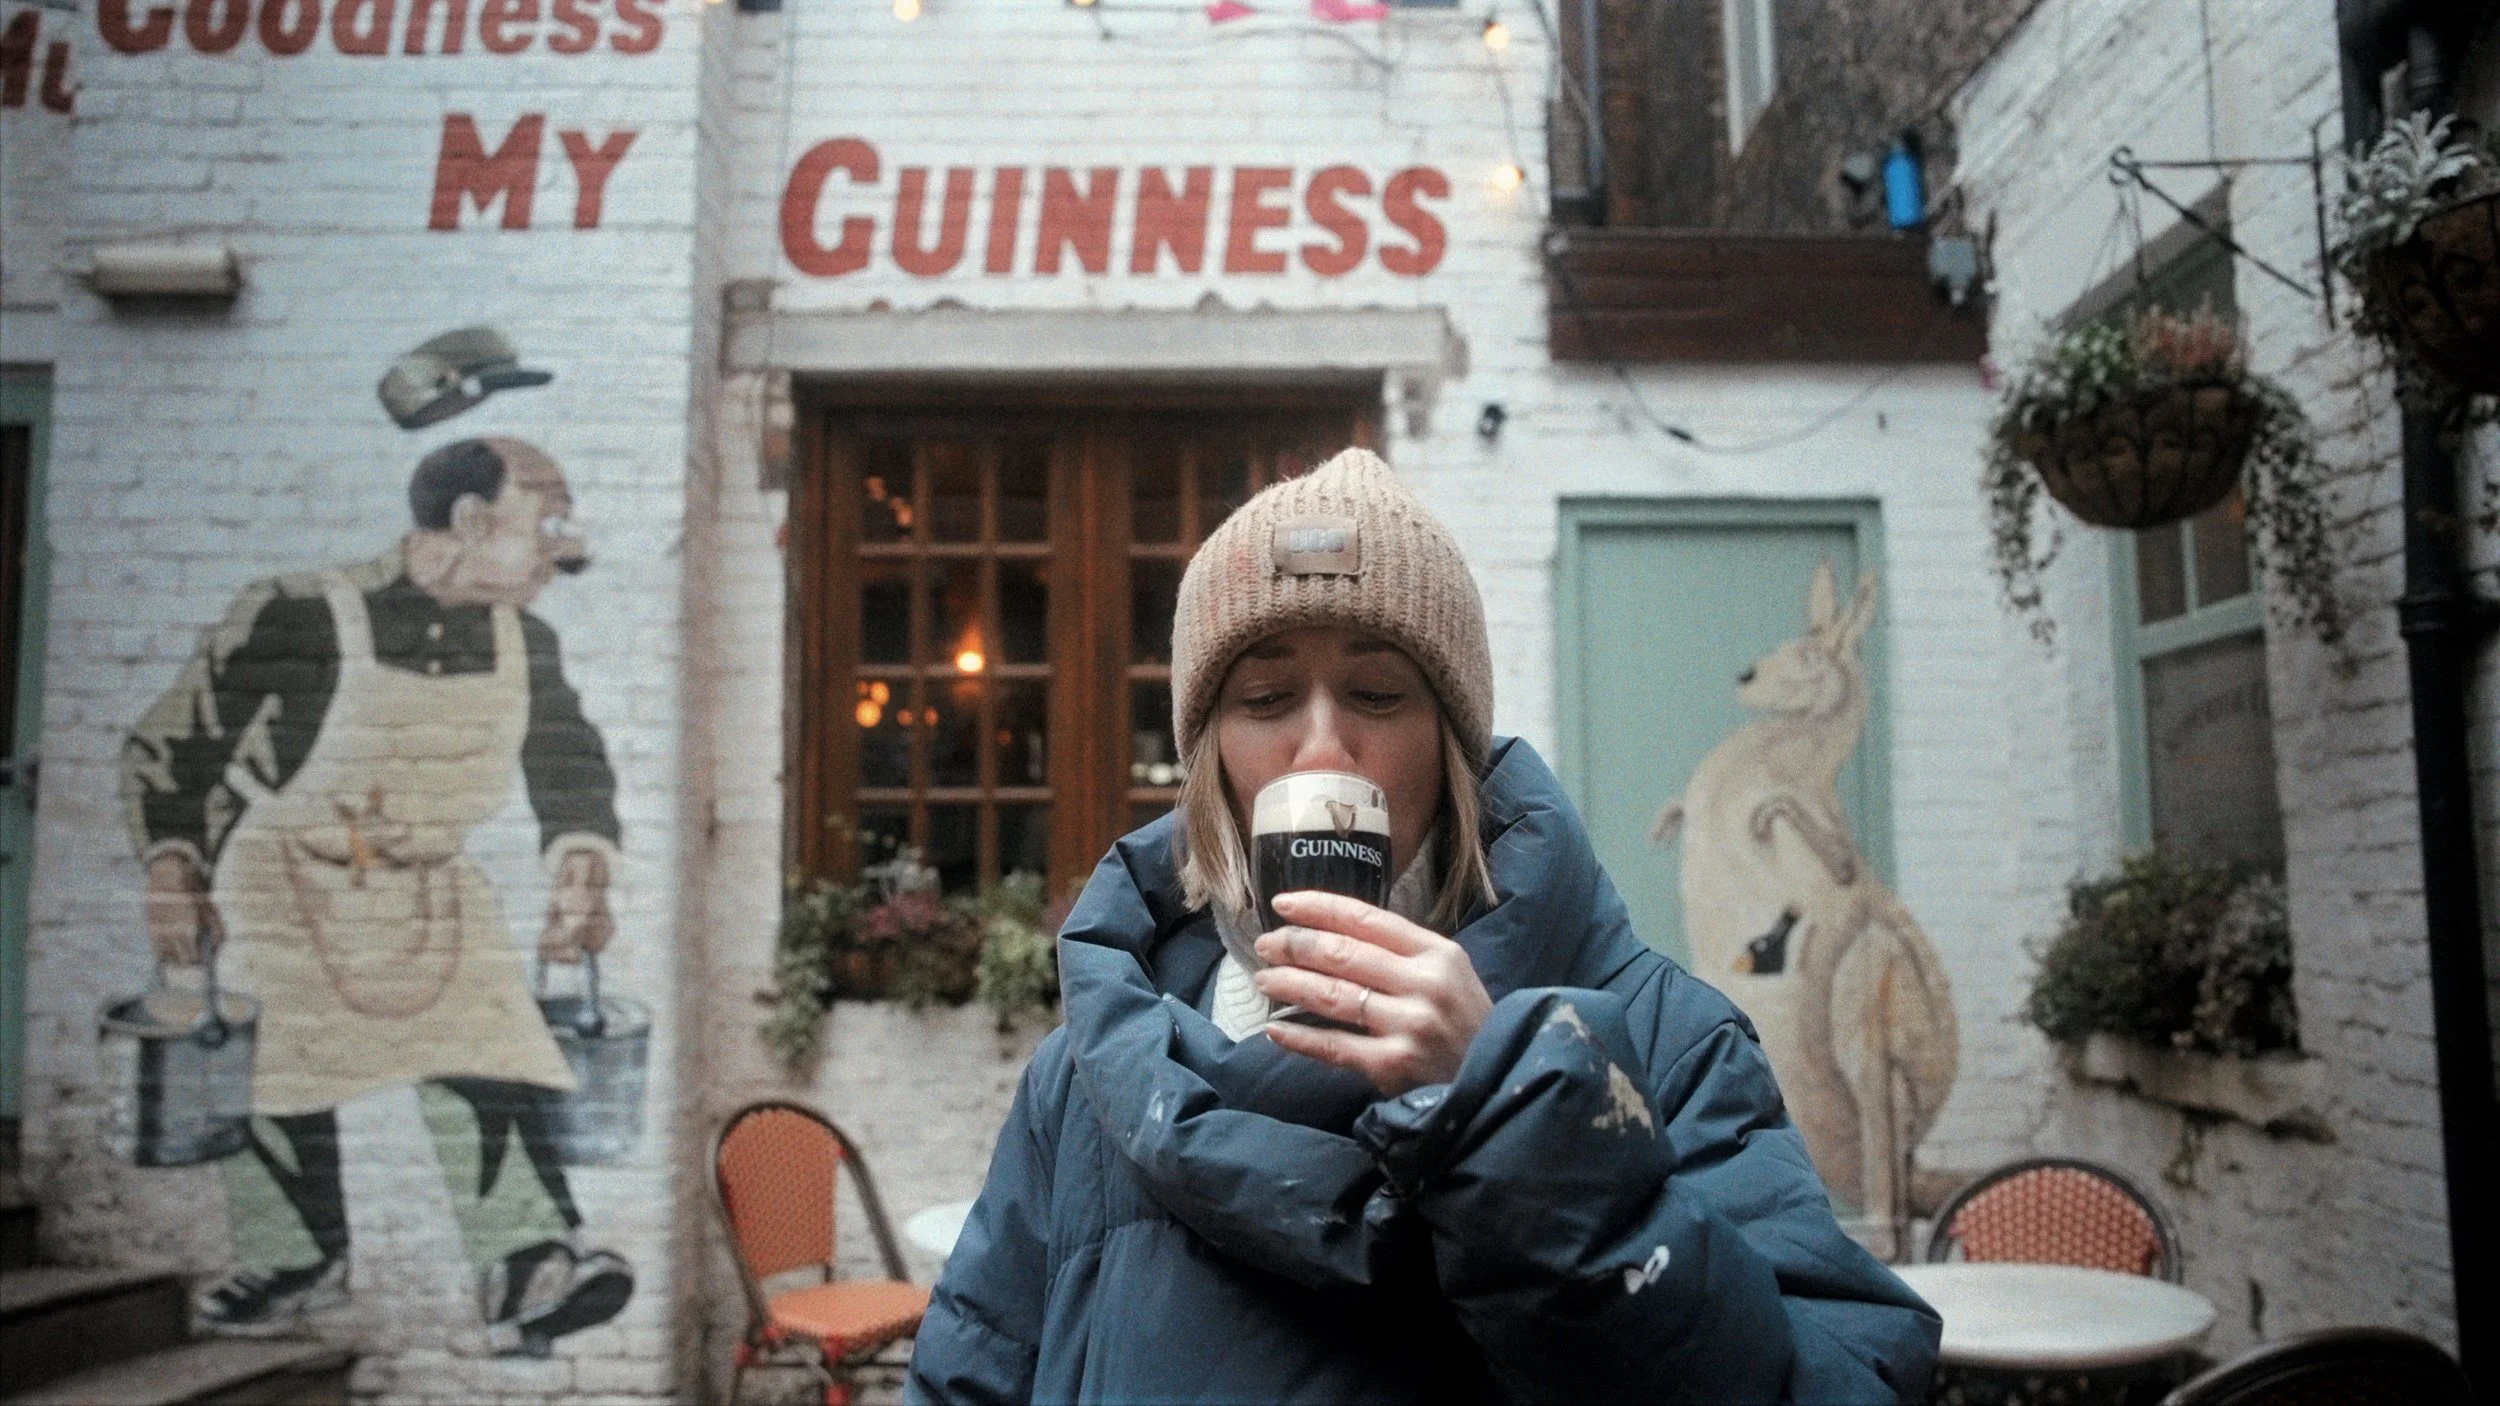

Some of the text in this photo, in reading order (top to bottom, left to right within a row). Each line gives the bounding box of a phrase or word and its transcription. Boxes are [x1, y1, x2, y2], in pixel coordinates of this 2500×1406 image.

[430, 114, 1452, 279] MY GUINNESS
[1291, 838, 1382, 867] GUINNESS
